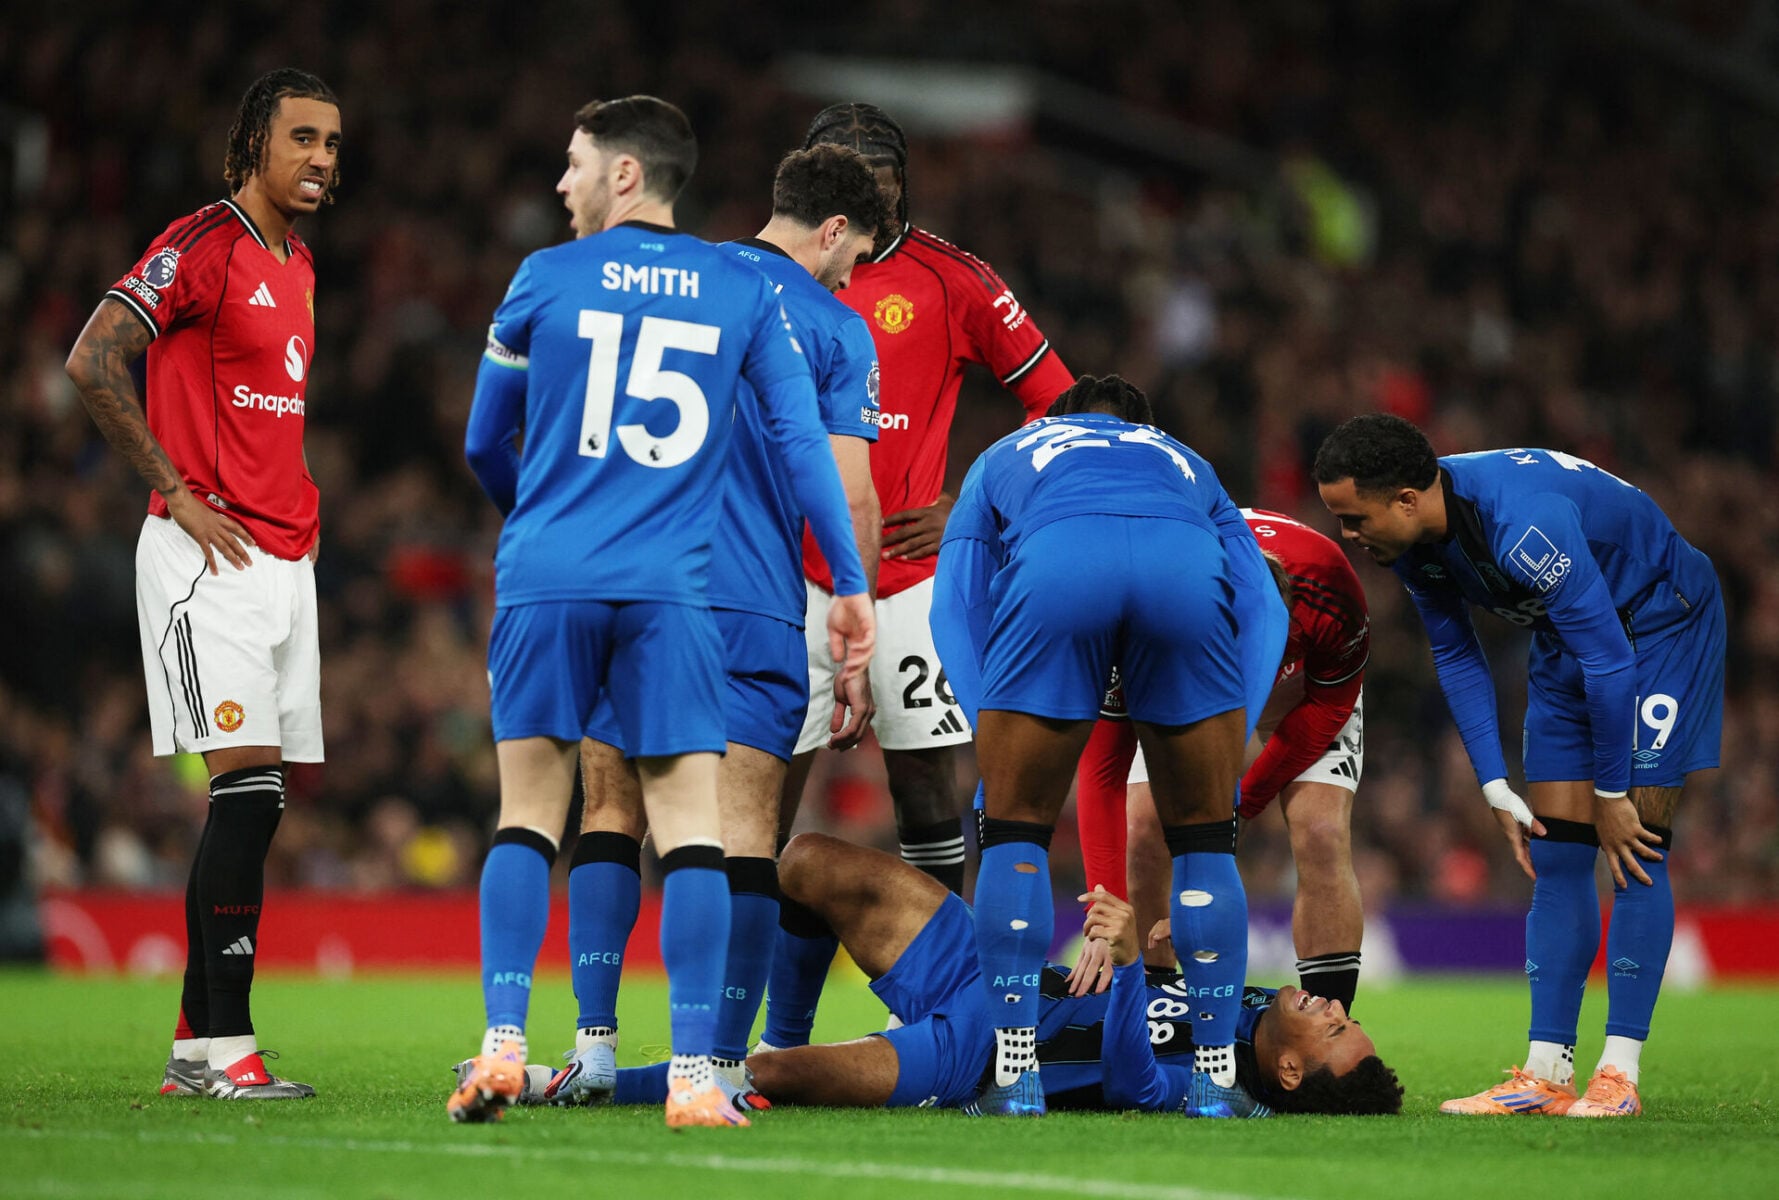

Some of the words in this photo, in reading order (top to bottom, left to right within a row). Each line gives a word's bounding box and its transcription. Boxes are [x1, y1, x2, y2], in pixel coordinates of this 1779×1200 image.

[737, 249, 761, 263] AFCB
[602, 261, 699, 299] SMITH
[127, 276, 140, 287] No
[138, 281, 159, 303] room
[132, 286, 158, 310] racism
[577, 308, 722, 469] 15
[1536, 553, 1572, 593] LEOS
[1633, 762, 1660, 770] umbro
[578, 952, 620, 968] AFCB
[492, 971, 531, 989] AFCB
[993, 974, 1039, 988] AFCB
[1187, 984, 1235, 999] AFCB
